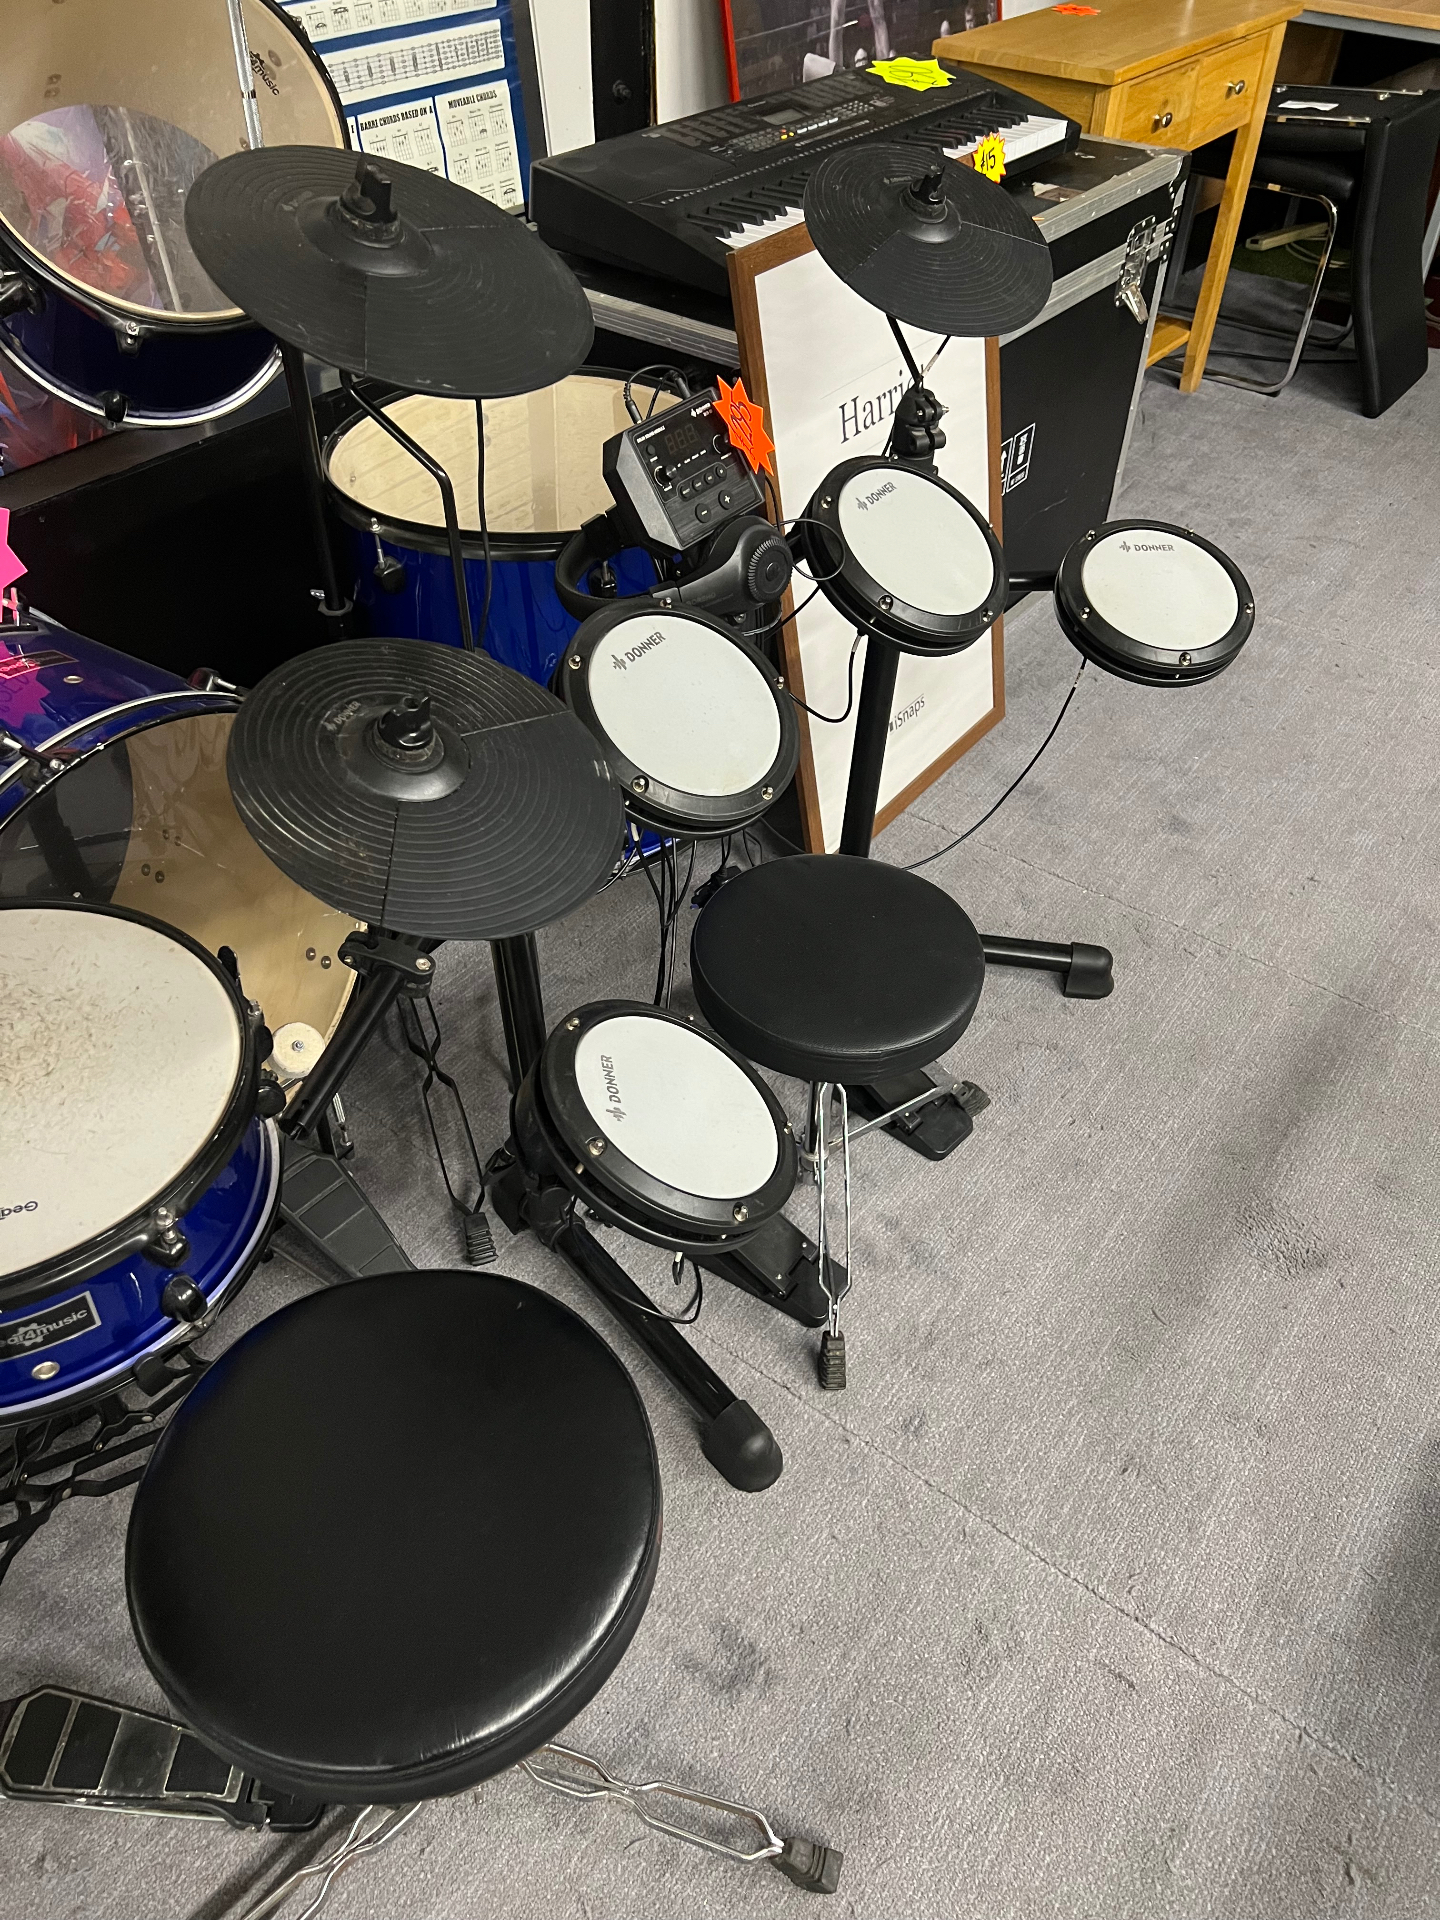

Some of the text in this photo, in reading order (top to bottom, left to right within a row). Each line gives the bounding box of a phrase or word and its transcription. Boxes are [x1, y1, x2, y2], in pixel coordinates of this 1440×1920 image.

[448, 90, 498, 109] MOVEABLE CHORDS
[380, 114, 400, 127] CHORDS
[401, 109, 418, 120] BASED
[420, 107, 427, 116] ON
[980, 147, 996, 173] £15
[839, 369, 916, 444] Harri
[865, 481, 897, 505] DONNER
[1133, 544, 1175, 552] DONNER
[624, 631, 666, 662] DONNER
[894, 696, 925, 730] iSnaps
[601, 1054, 622, 1104] DONNER
[0, 1201, 38, 1218] Gea
[0, 1309, 88, 1347] ear4music
